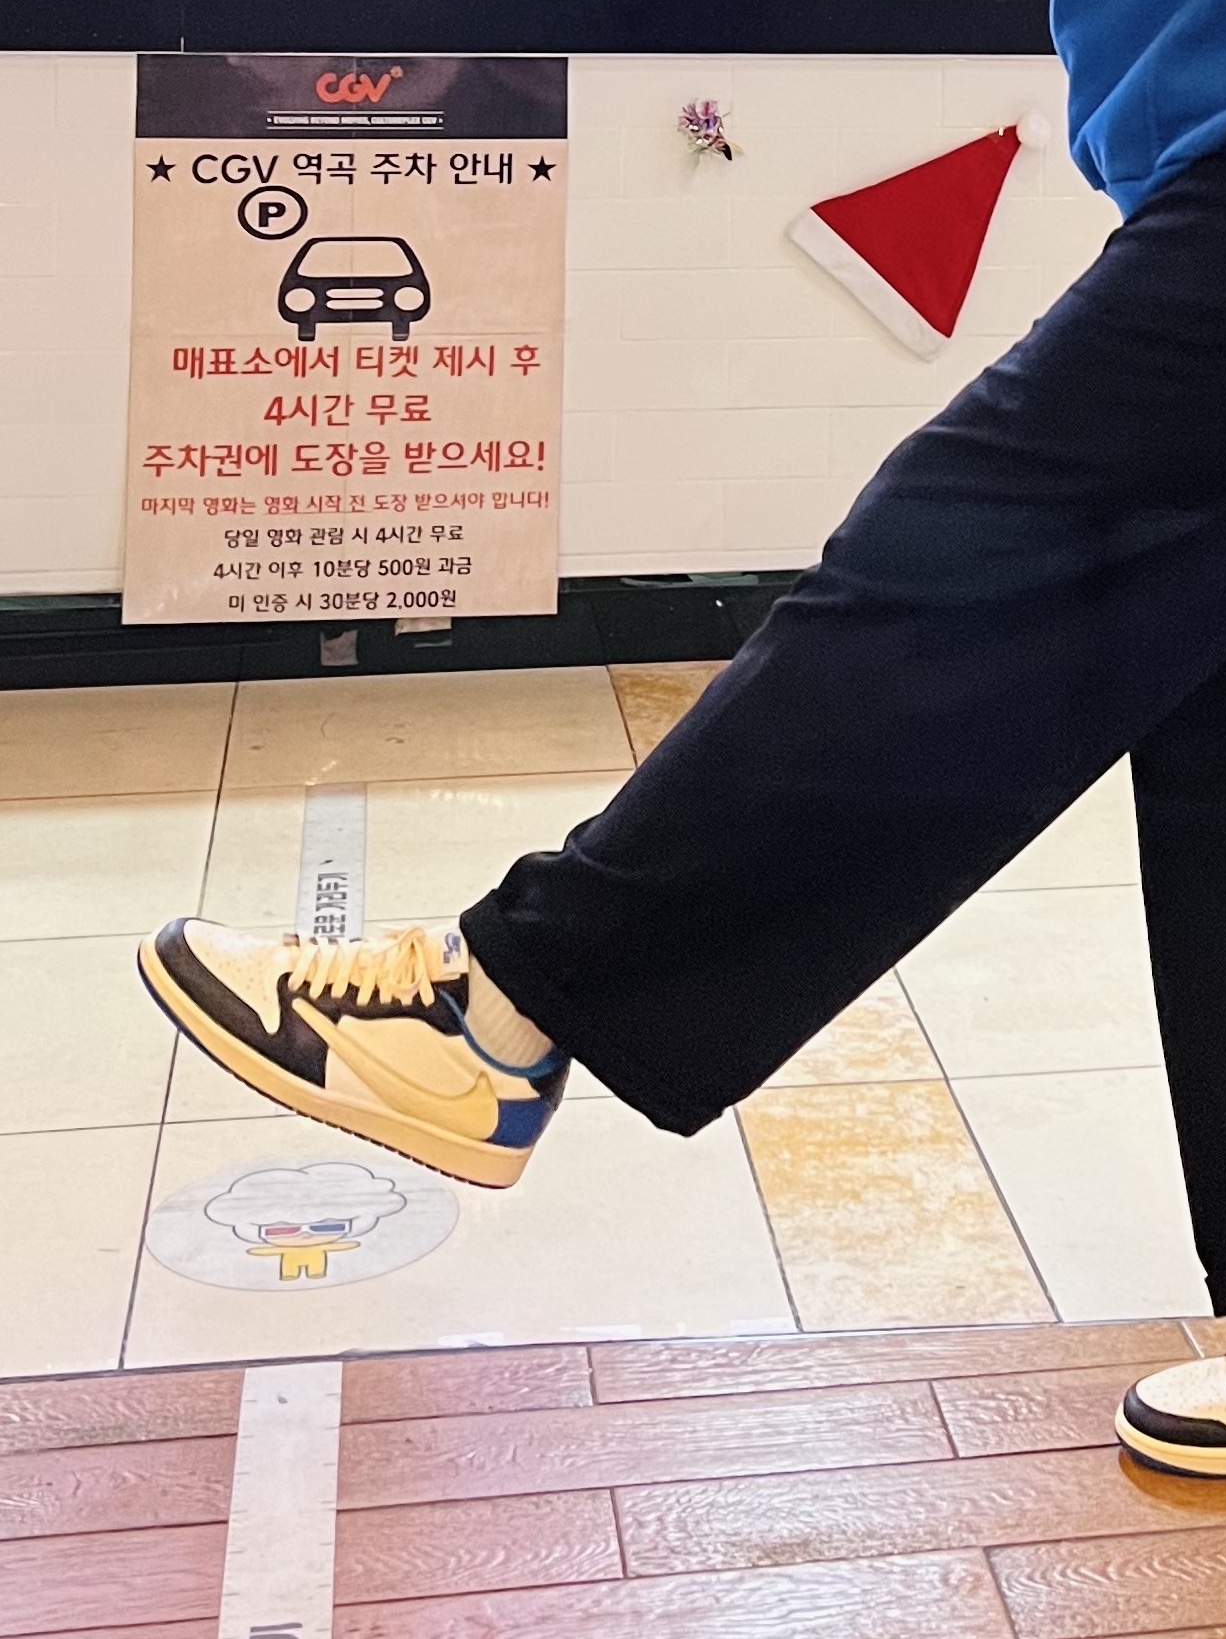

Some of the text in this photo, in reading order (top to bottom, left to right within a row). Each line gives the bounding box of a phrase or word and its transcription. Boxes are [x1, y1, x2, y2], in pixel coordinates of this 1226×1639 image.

[315, 66, 403, 103] CGV
[191, 152, 513, 186] CGV 역곡 주차 안내
[257, 201, 287, 228] P
[172, 343, 541, 380] 매표소에서 티켓 제시 후
[263, 393, 432, 427] 4시간 무료
[142, 440, 545, 478] 주차권에 도장을 받으세요!
[141, 491, 549, 516] 마지막 영화는 영화 시작 전 도장 받으셔야 합니다!
[224, 524, 464, 549] 당일 영화 관람 시 4시간 무료
[212, 556, 473, 581] 4시간 이후 10분당 500원 과금
[228, 588, 457, 614] 미 인증 시 30분당 2,000원
